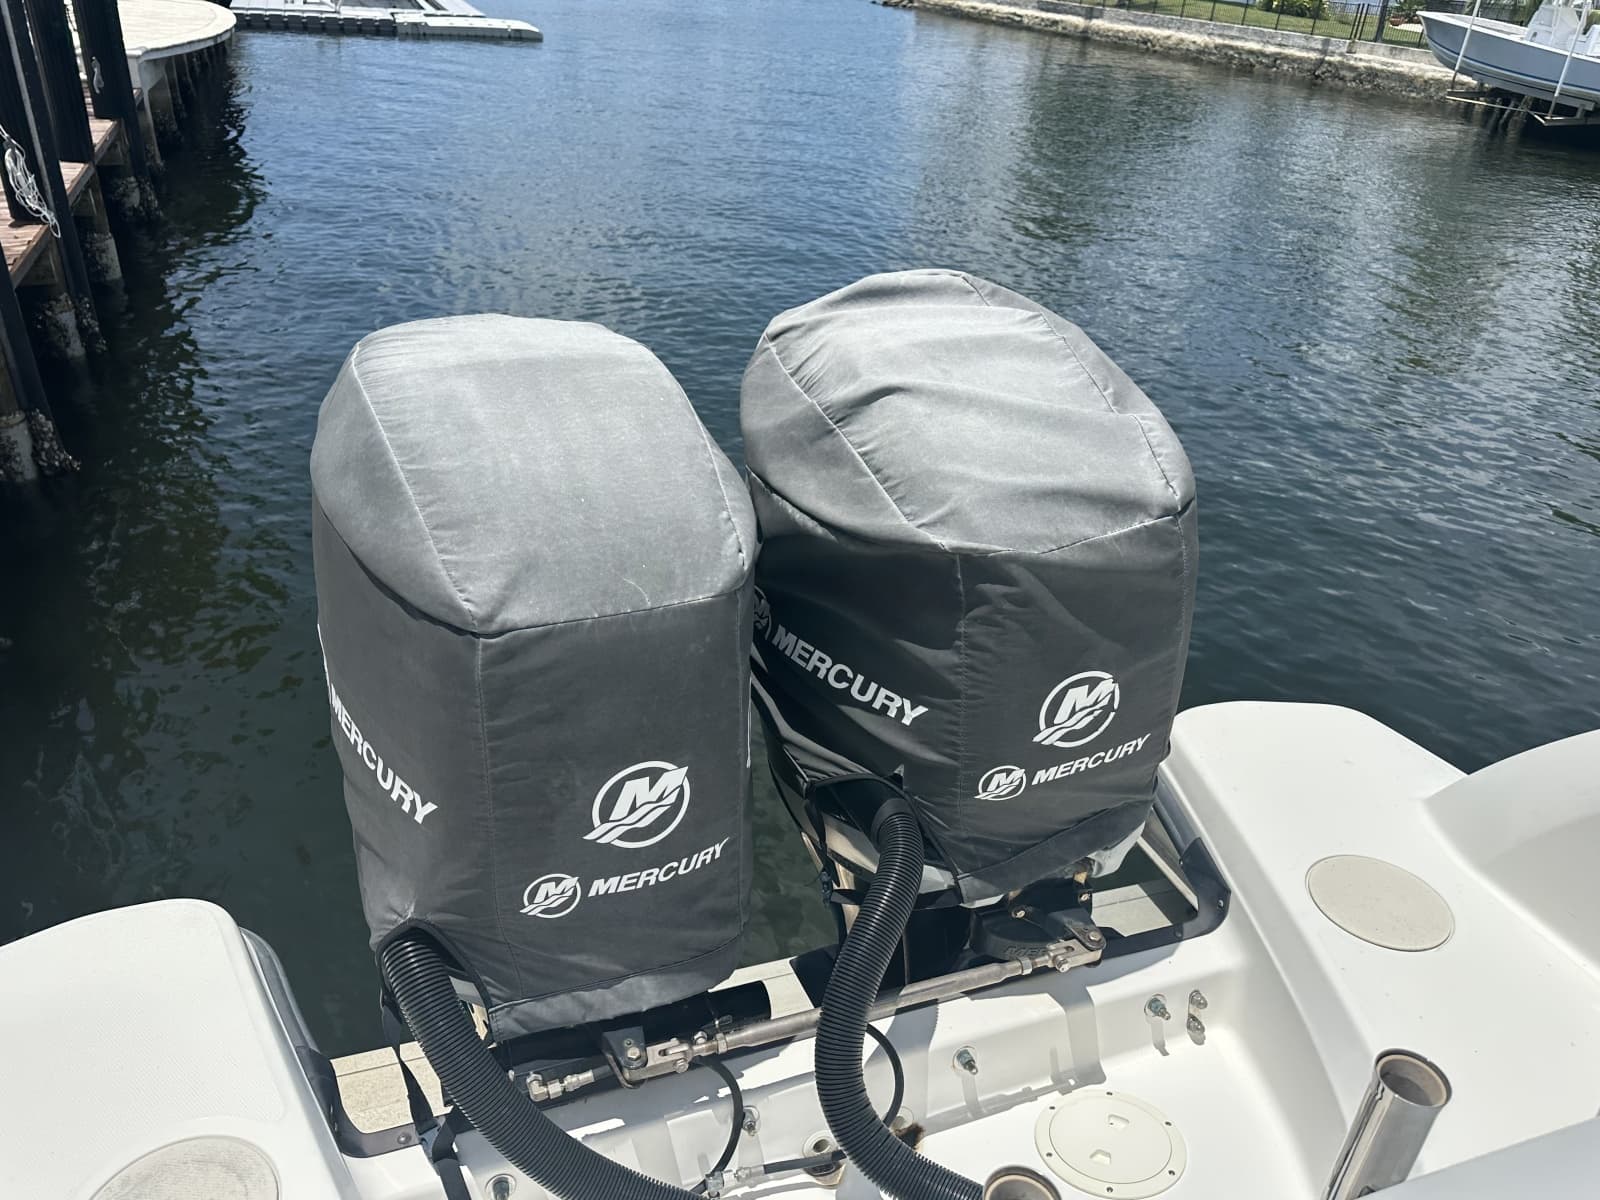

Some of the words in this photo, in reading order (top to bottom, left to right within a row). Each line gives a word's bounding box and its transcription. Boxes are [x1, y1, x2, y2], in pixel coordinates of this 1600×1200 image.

[771, 625, 929, 726] MERCURY
[330, 683, 439, 825] MERCURY
[1031, 733, 1151, 786] MERCURY
[587, 836, 731, 898] MERCURY
